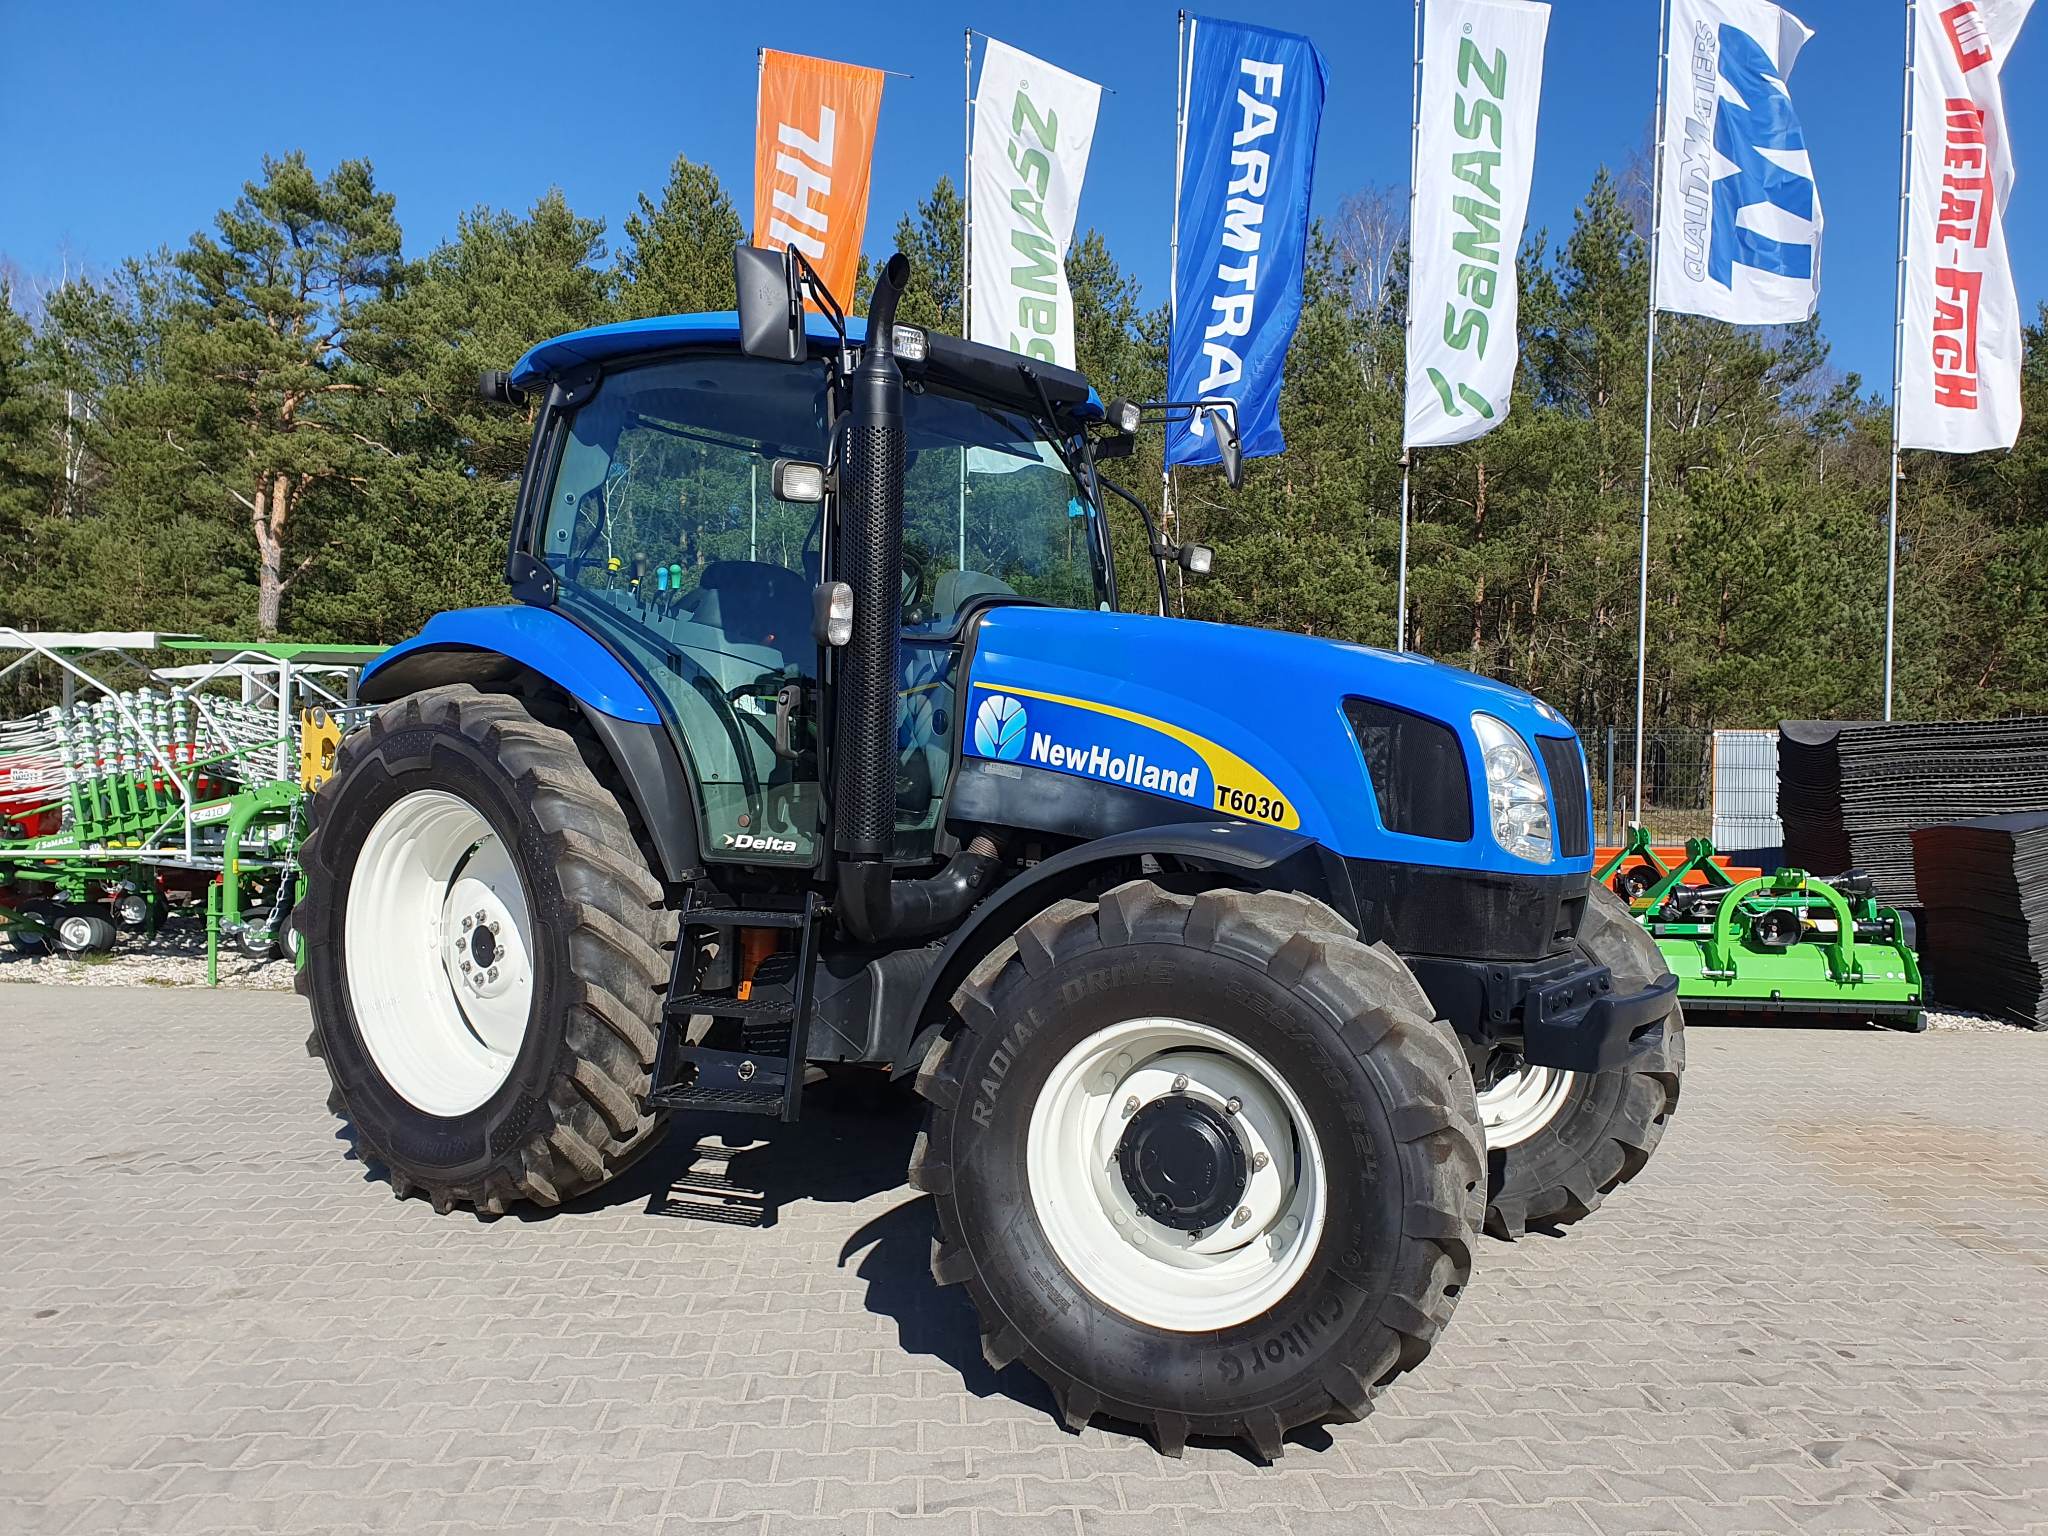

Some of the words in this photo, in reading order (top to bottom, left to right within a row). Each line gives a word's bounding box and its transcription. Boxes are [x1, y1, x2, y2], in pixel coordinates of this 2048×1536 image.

[1443, 36, 1507, 361] SaMASZ
[1708, 22, 1813, 291] TYM
[1192, 57, 1284, 437] FARMTRAC
[1933, 97, 1993, 410] METAL-FACH
[194, 807, 224, 821] Z-410
[734, 833, 797, 852] Delta
[1216, 784, 1285, 823] T6030
[971, 1006, 1048, 1129] RADIAL
[1251, 1292, 1345, 1374] Cultor
